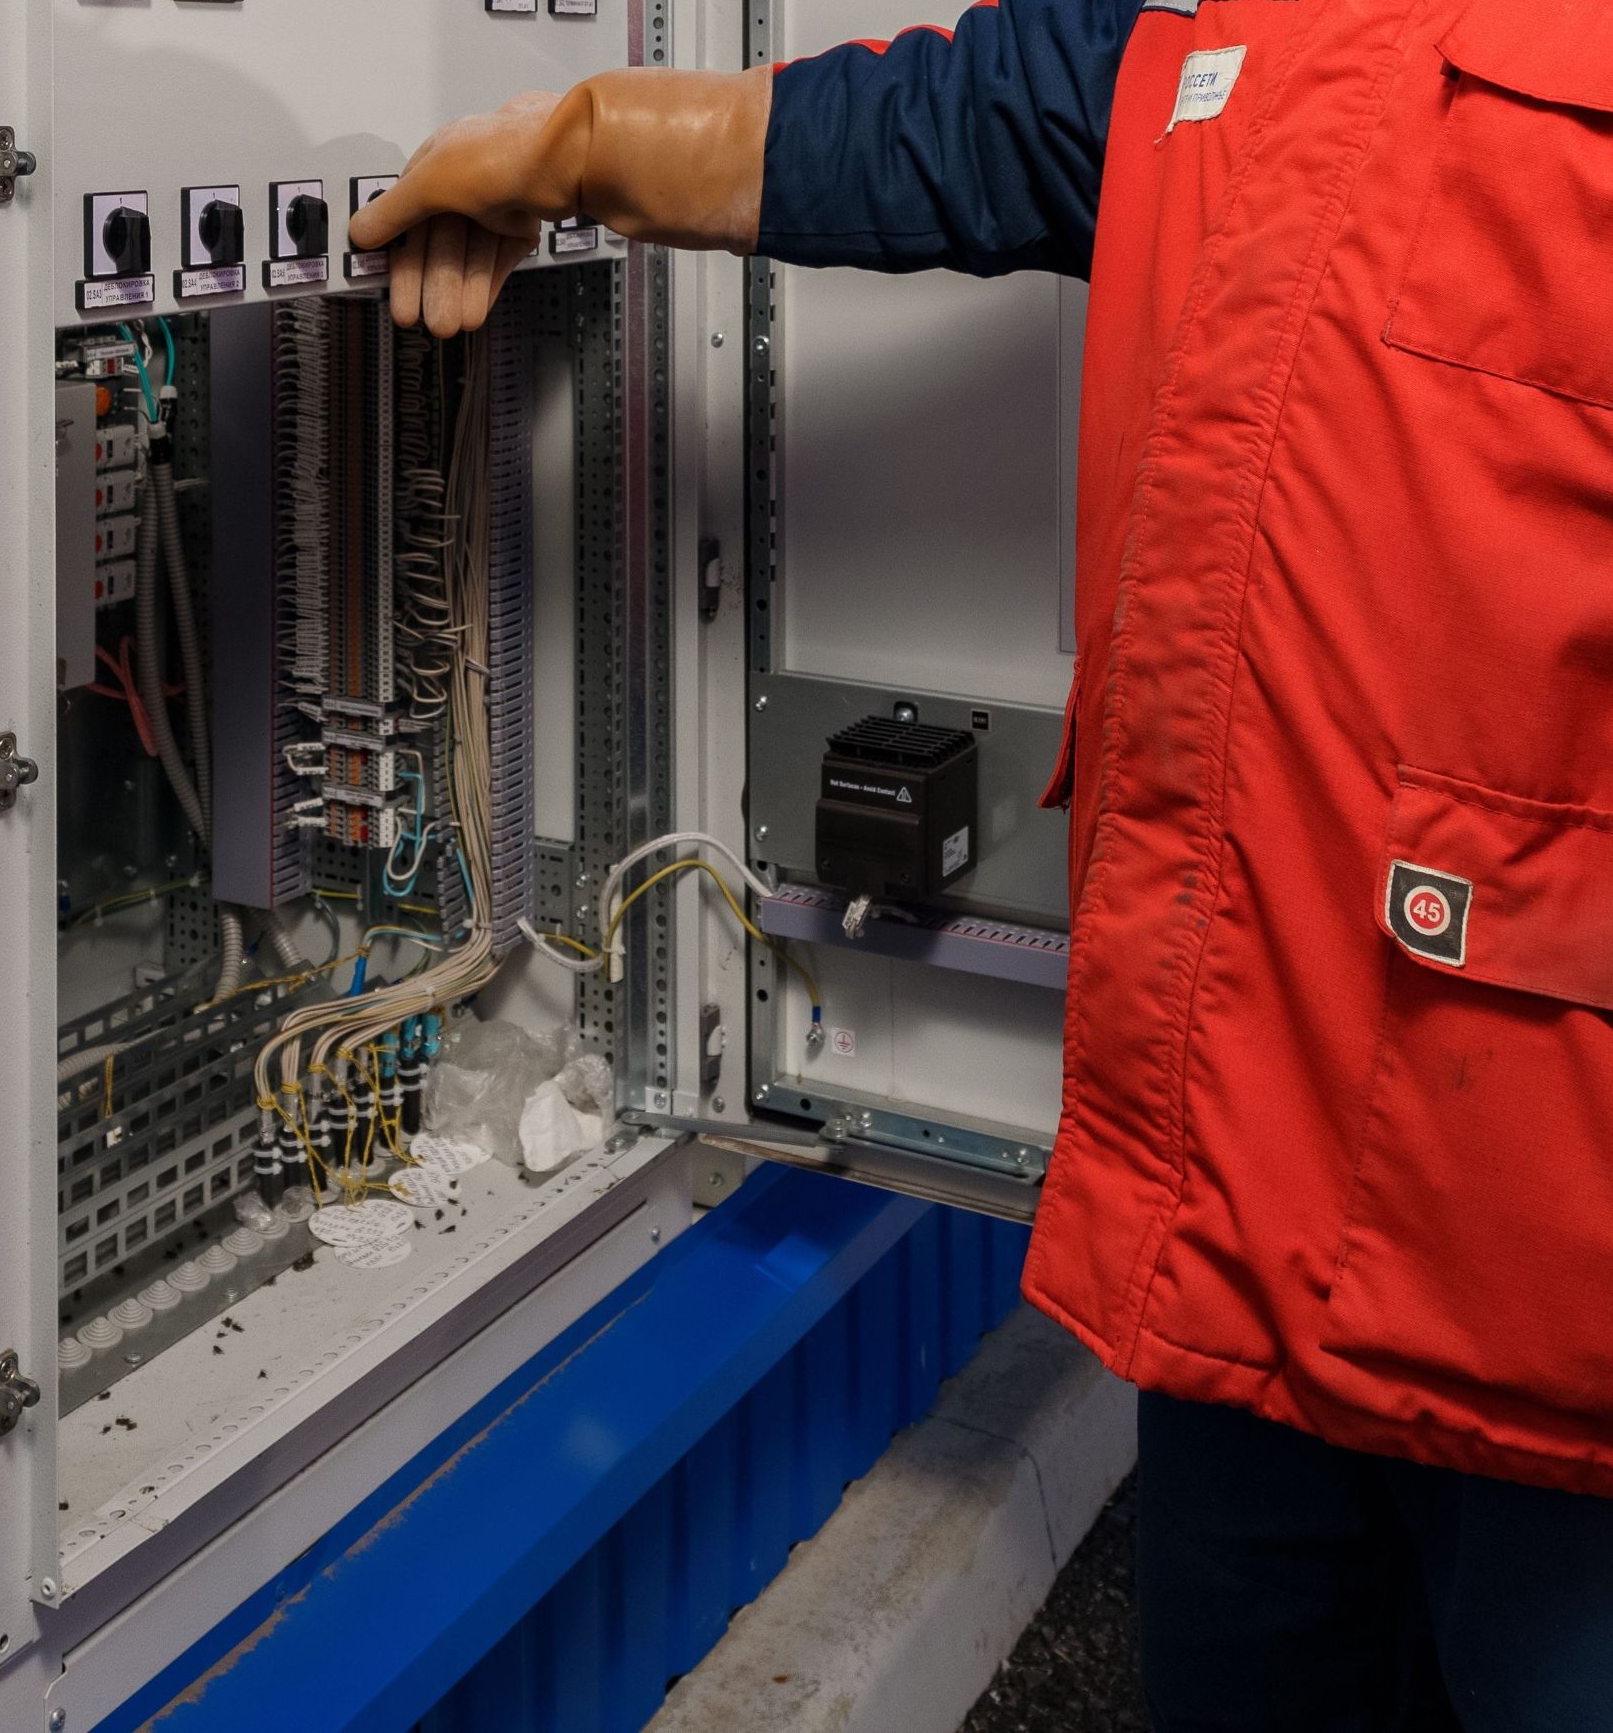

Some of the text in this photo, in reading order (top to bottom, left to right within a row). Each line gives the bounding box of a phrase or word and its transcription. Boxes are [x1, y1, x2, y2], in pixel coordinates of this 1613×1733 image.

[199, 268, 240, 280] ДЕБЛОКИРОВКА
[103, 278, 150, 292] ДЕБЛОКИРОВКА
[200, 281, 235, 291] УПРАВЛЕНИЯ
[105, 293, 145, 303] УПРАВЛЕНИЯ
[1413, 899, 1441, 923] 45
